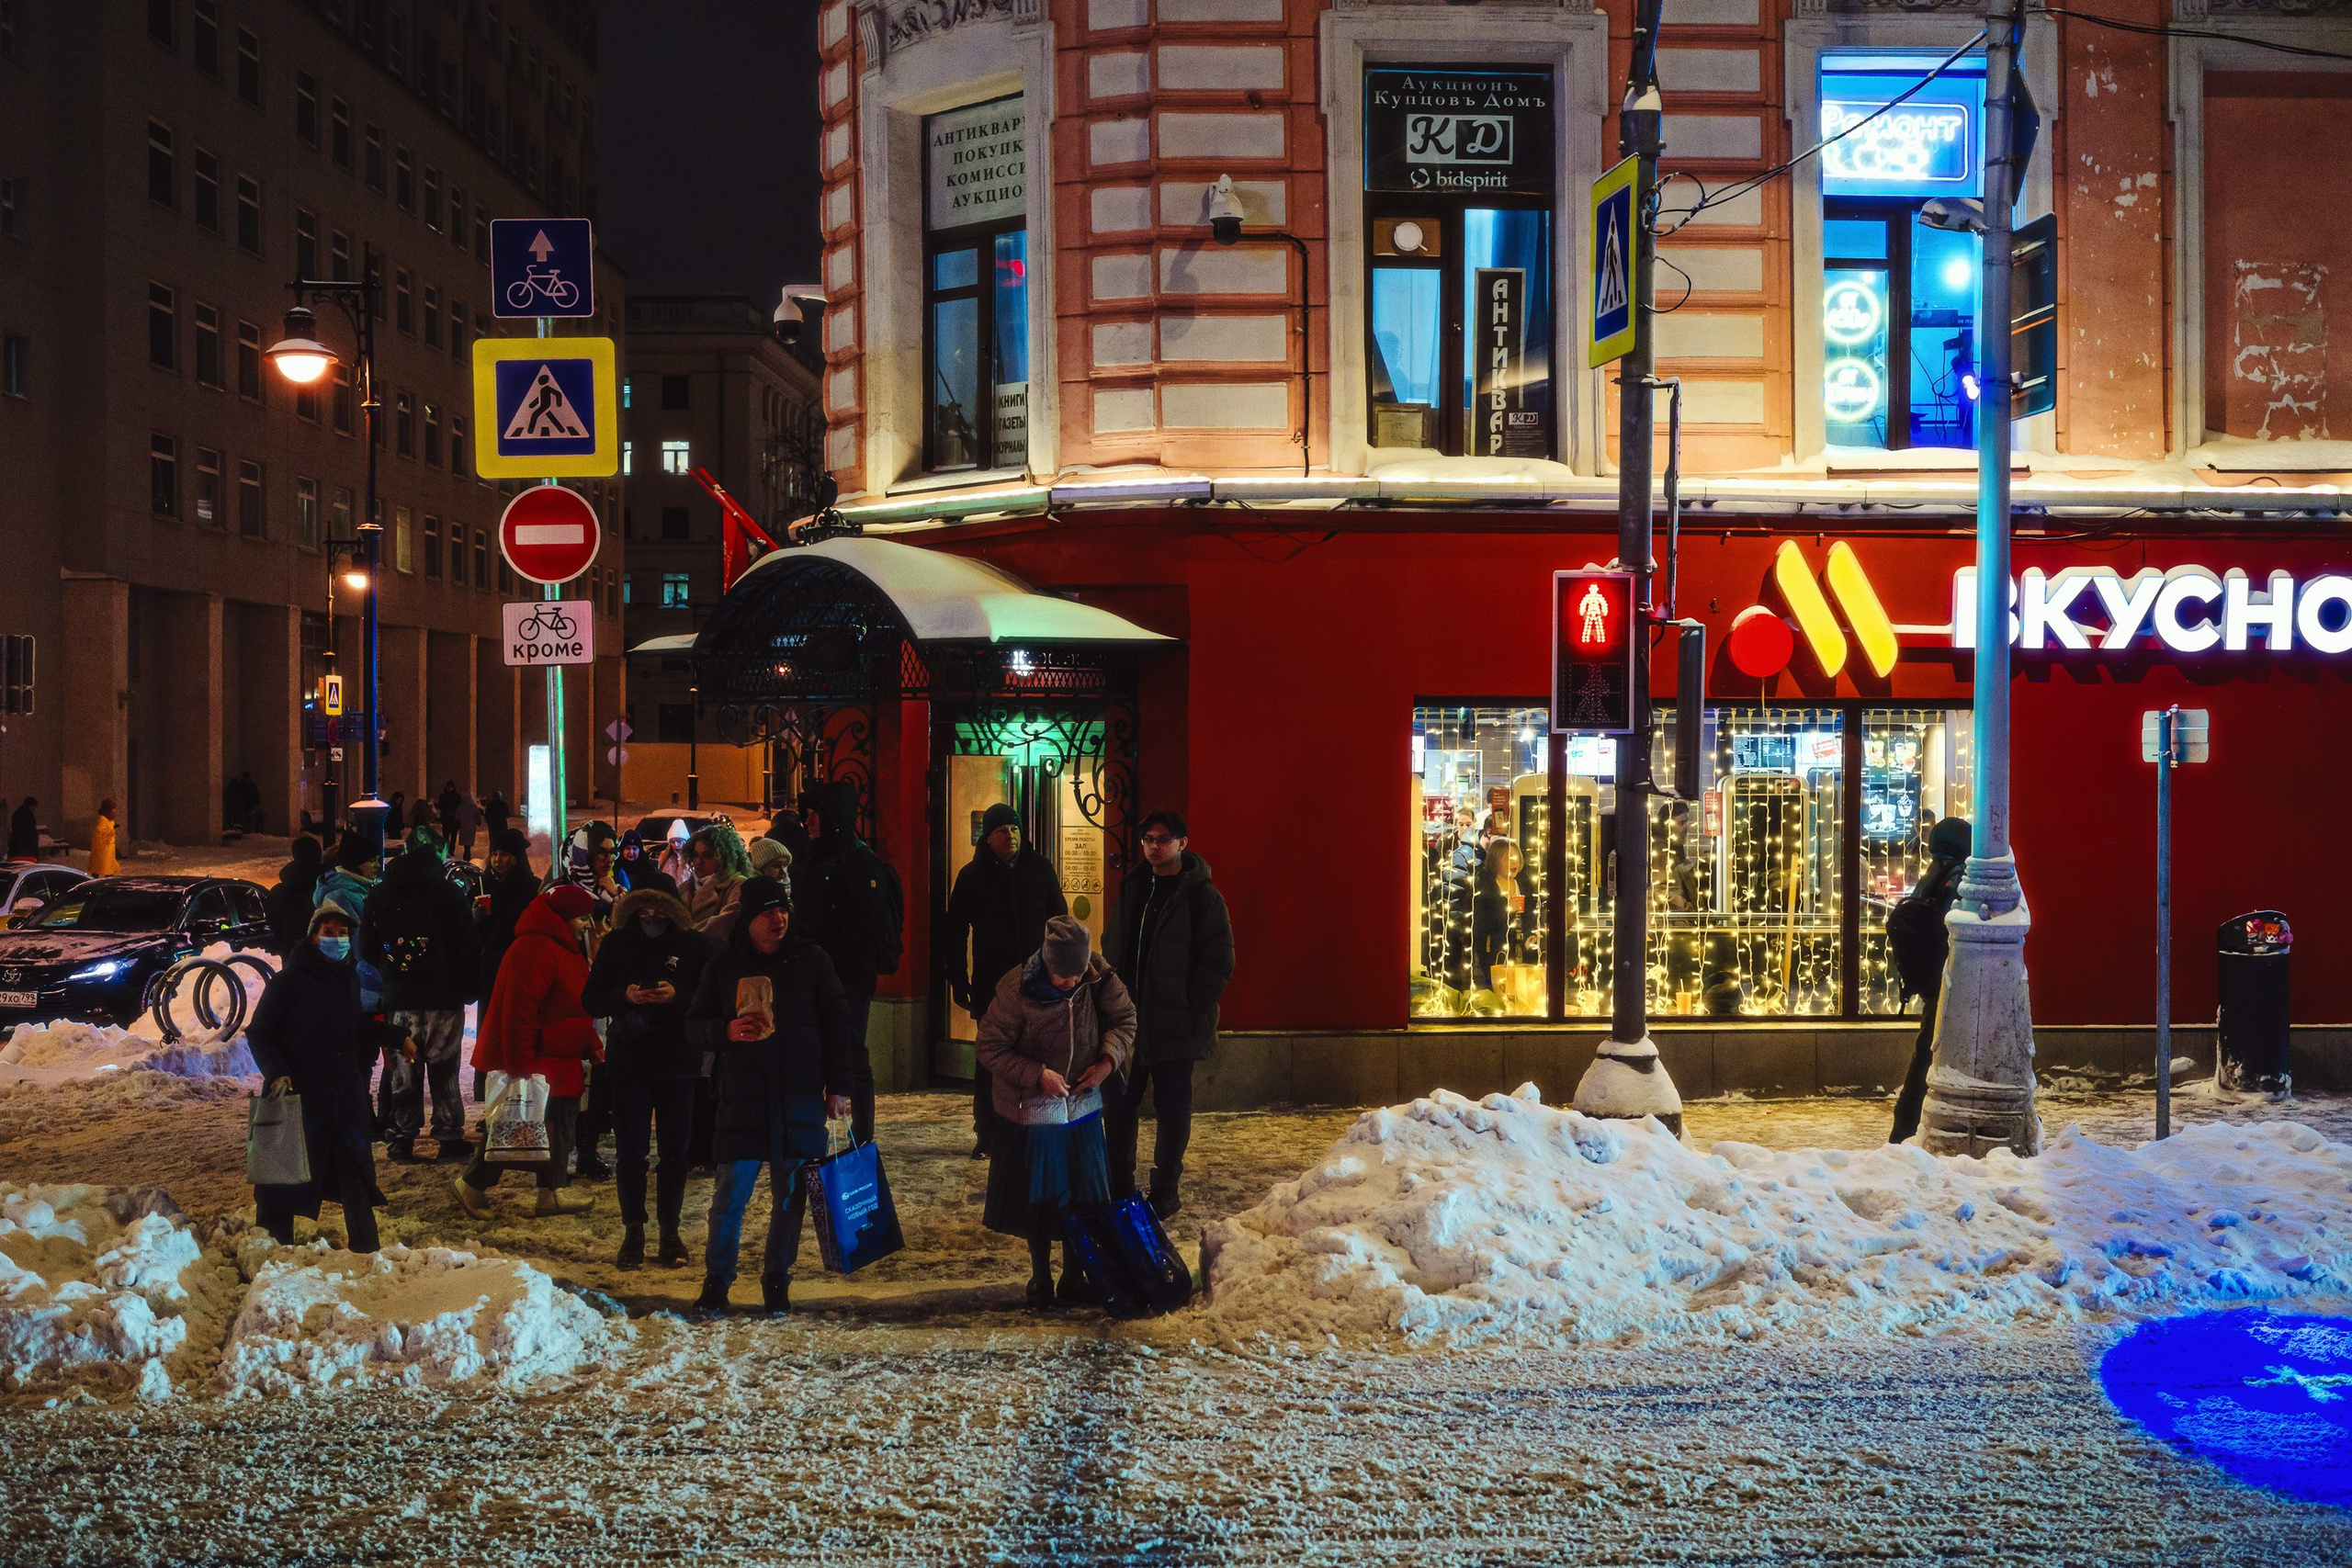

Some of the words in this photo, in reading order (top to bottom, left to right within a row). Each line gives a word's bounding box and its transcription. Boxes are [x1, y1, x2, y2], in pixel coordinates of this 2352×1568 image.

[1401, 75, 1518, 94] Аукционъ
[1374, 90, 1476, 108] Купцовъ
[1484, 93, 1545, 107] Домъ
[933, 117, 1025, 147] АНТИКВАР
[1436, 171, 1508, 192] bidspirit
[1489, 278, 1509, 455] АНТИКВАР
[998, 393, 1025, 409] КНИГИ
[999, 416, 1025, 431] ГАЗЕТЫ
[513, 642, 583, 663] кроме
[844, 1194, 876, 1213] СКАЗОЧНЫЙ
[848, 1207, 868, 1221] НОВЫЙ
[867, 1202, 878, 1212] ГОД
